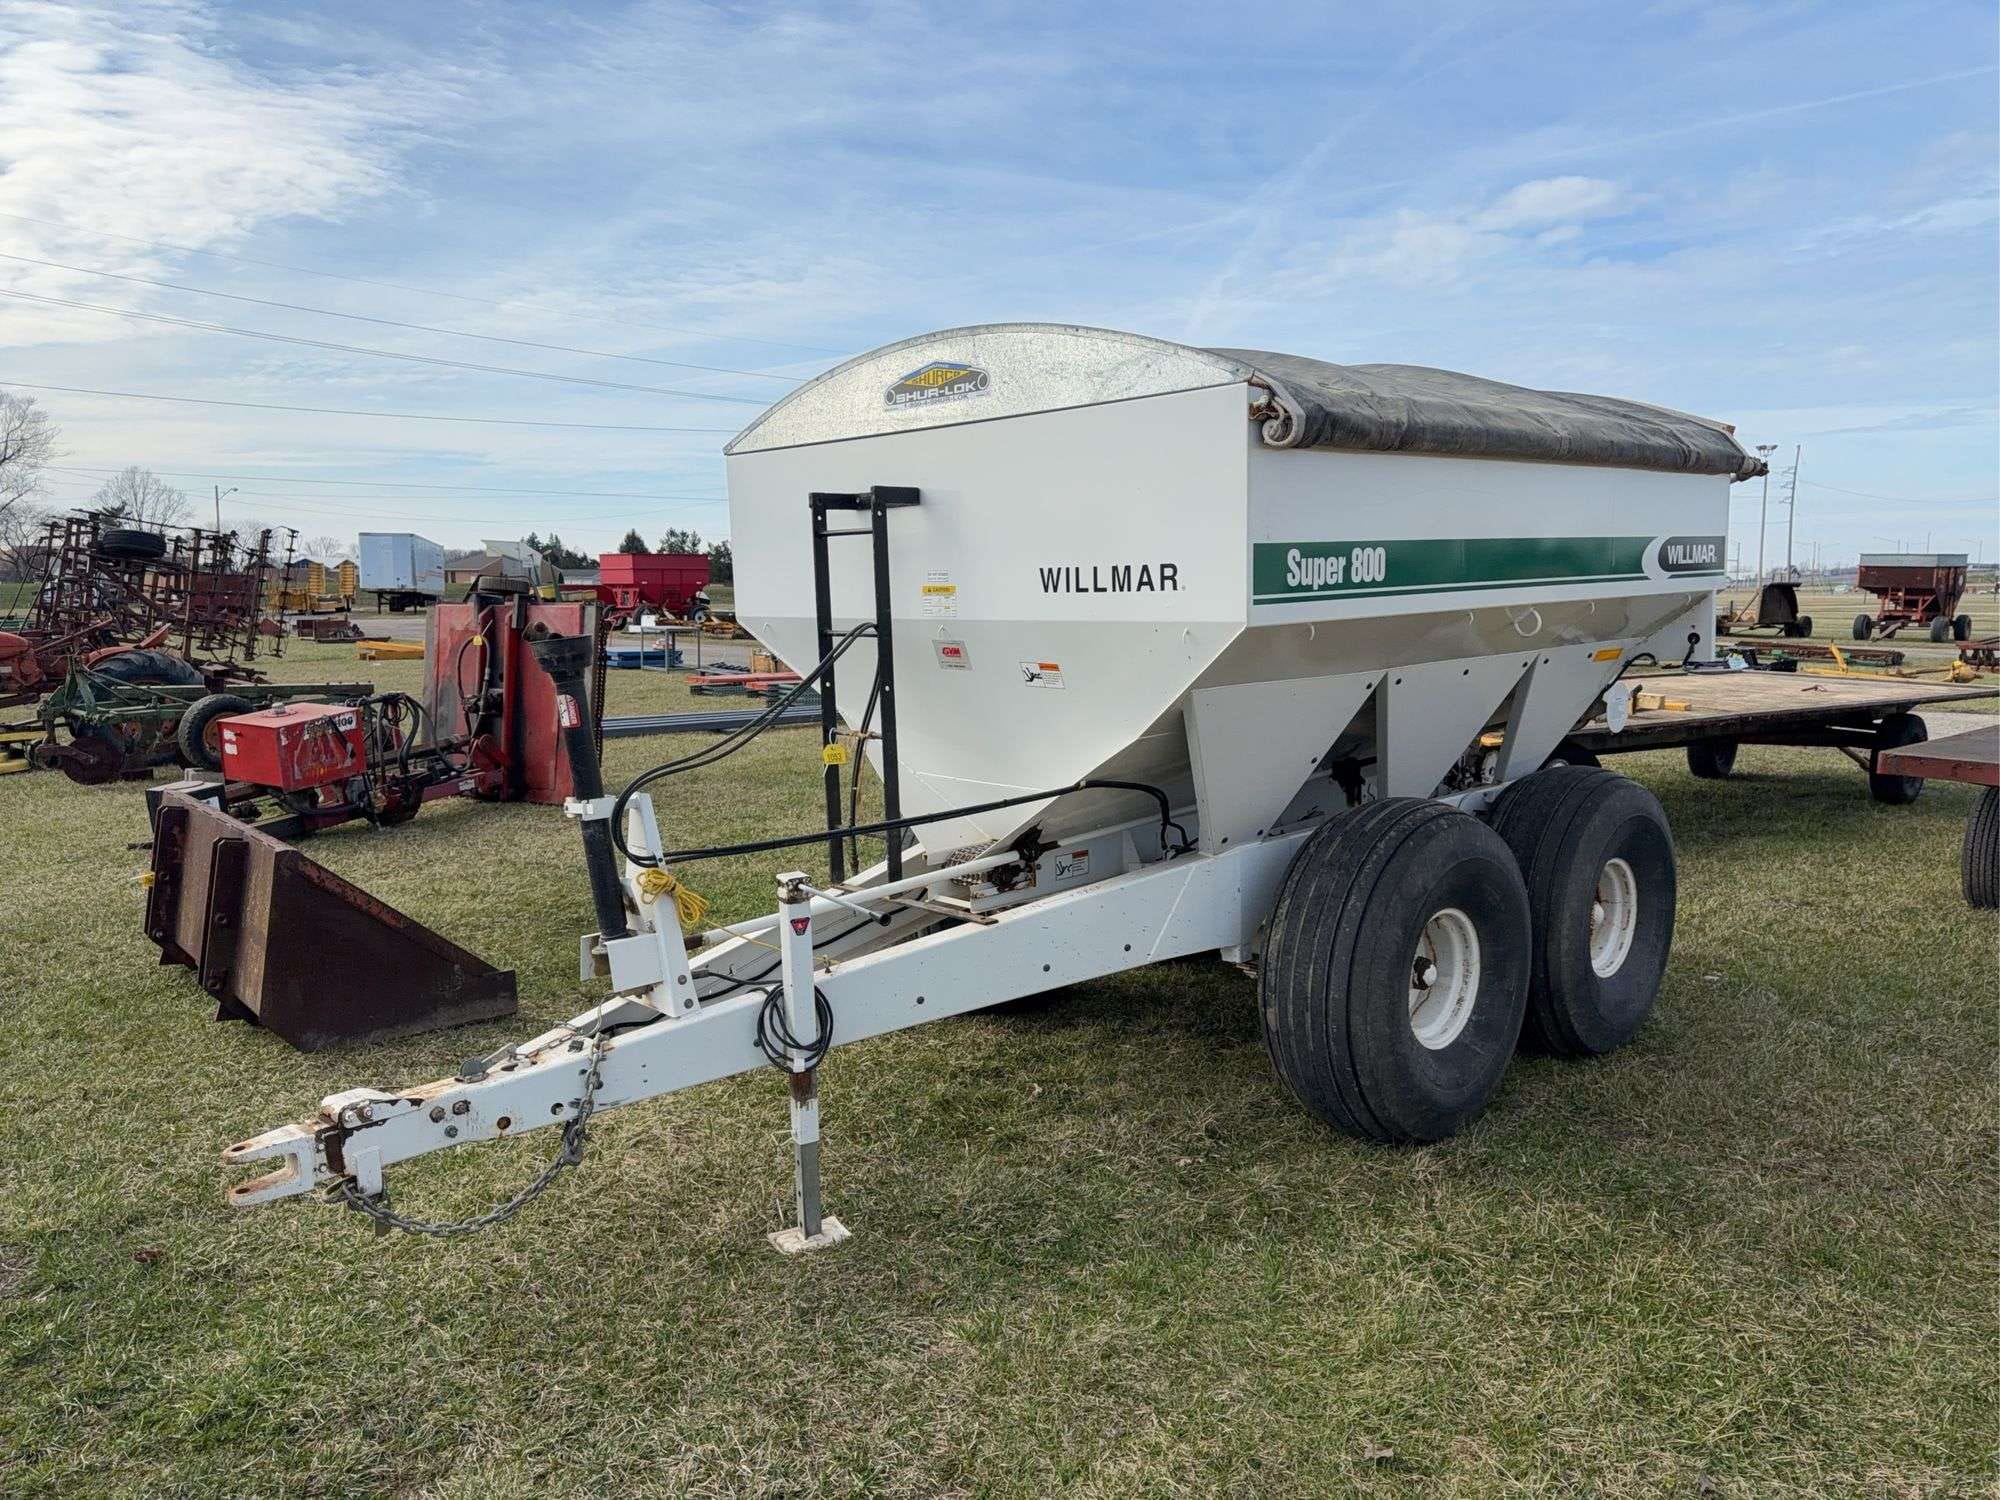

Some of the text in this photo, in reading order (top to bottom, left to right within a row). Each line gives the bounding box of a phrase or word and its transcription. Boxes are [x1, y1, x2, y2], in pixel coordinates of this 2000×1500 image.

[895, 381, 977, 403] SHUR-LOK
[1667, 544, 1716, 565] WILLMAR
[1039, 563, 1179, 593] WILLMAR
[1286, 547, 1386, 590] Super 800
